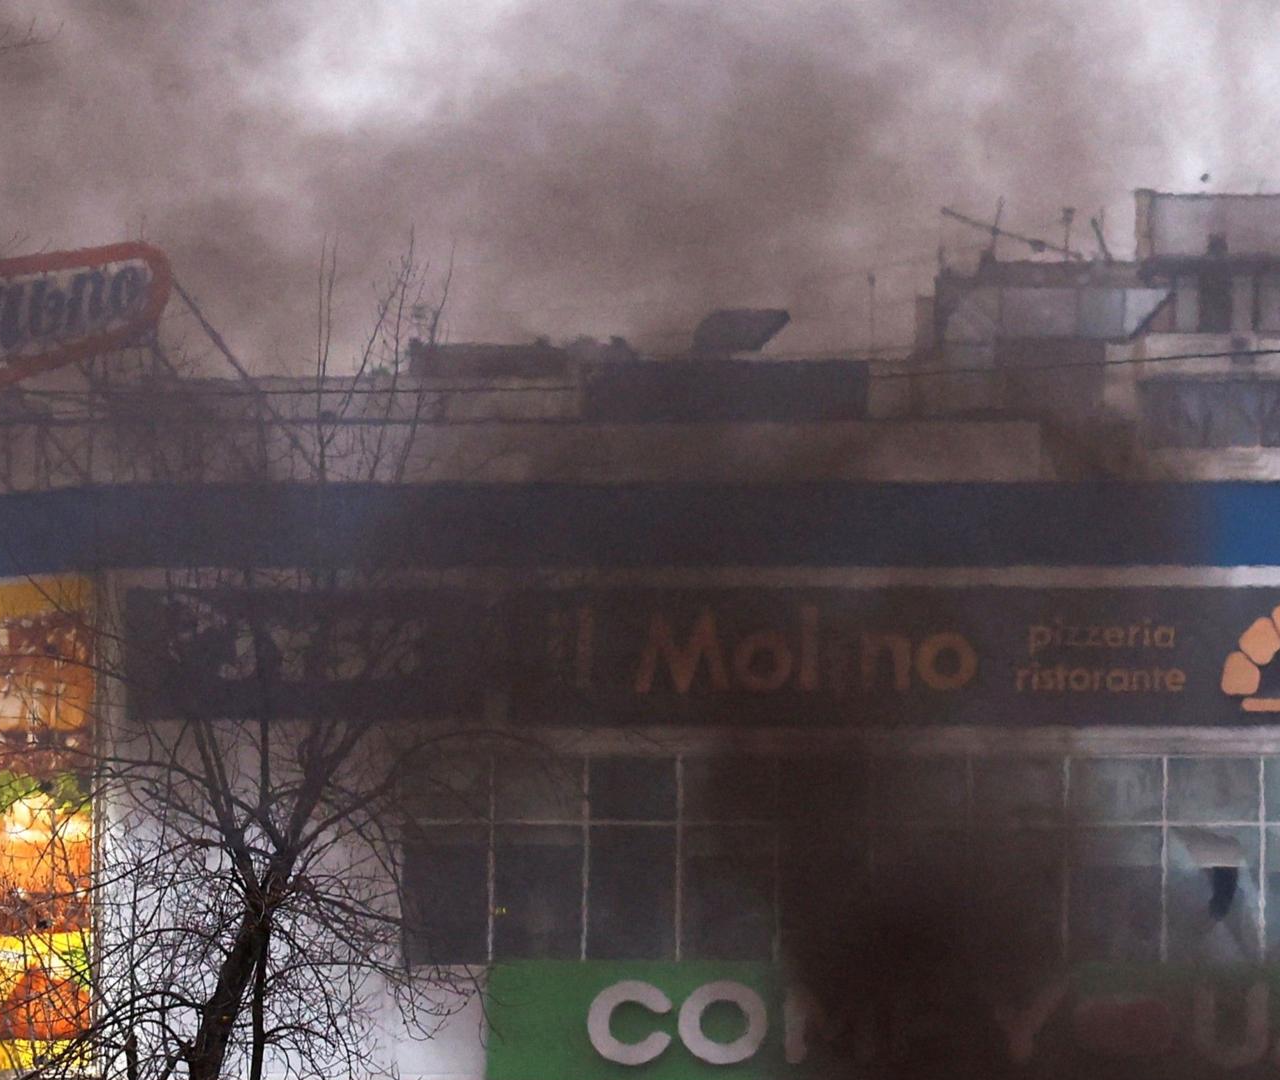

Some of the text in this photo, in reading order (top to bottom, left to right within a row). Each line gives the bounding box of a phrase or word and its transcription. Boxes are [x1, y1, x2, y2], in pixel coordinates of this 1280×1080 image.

[1027, 616, 1177, 650] pizzeria
[1014, 661, 1188, 694] ristorante
[586, 977, 1072, 1066] COY
